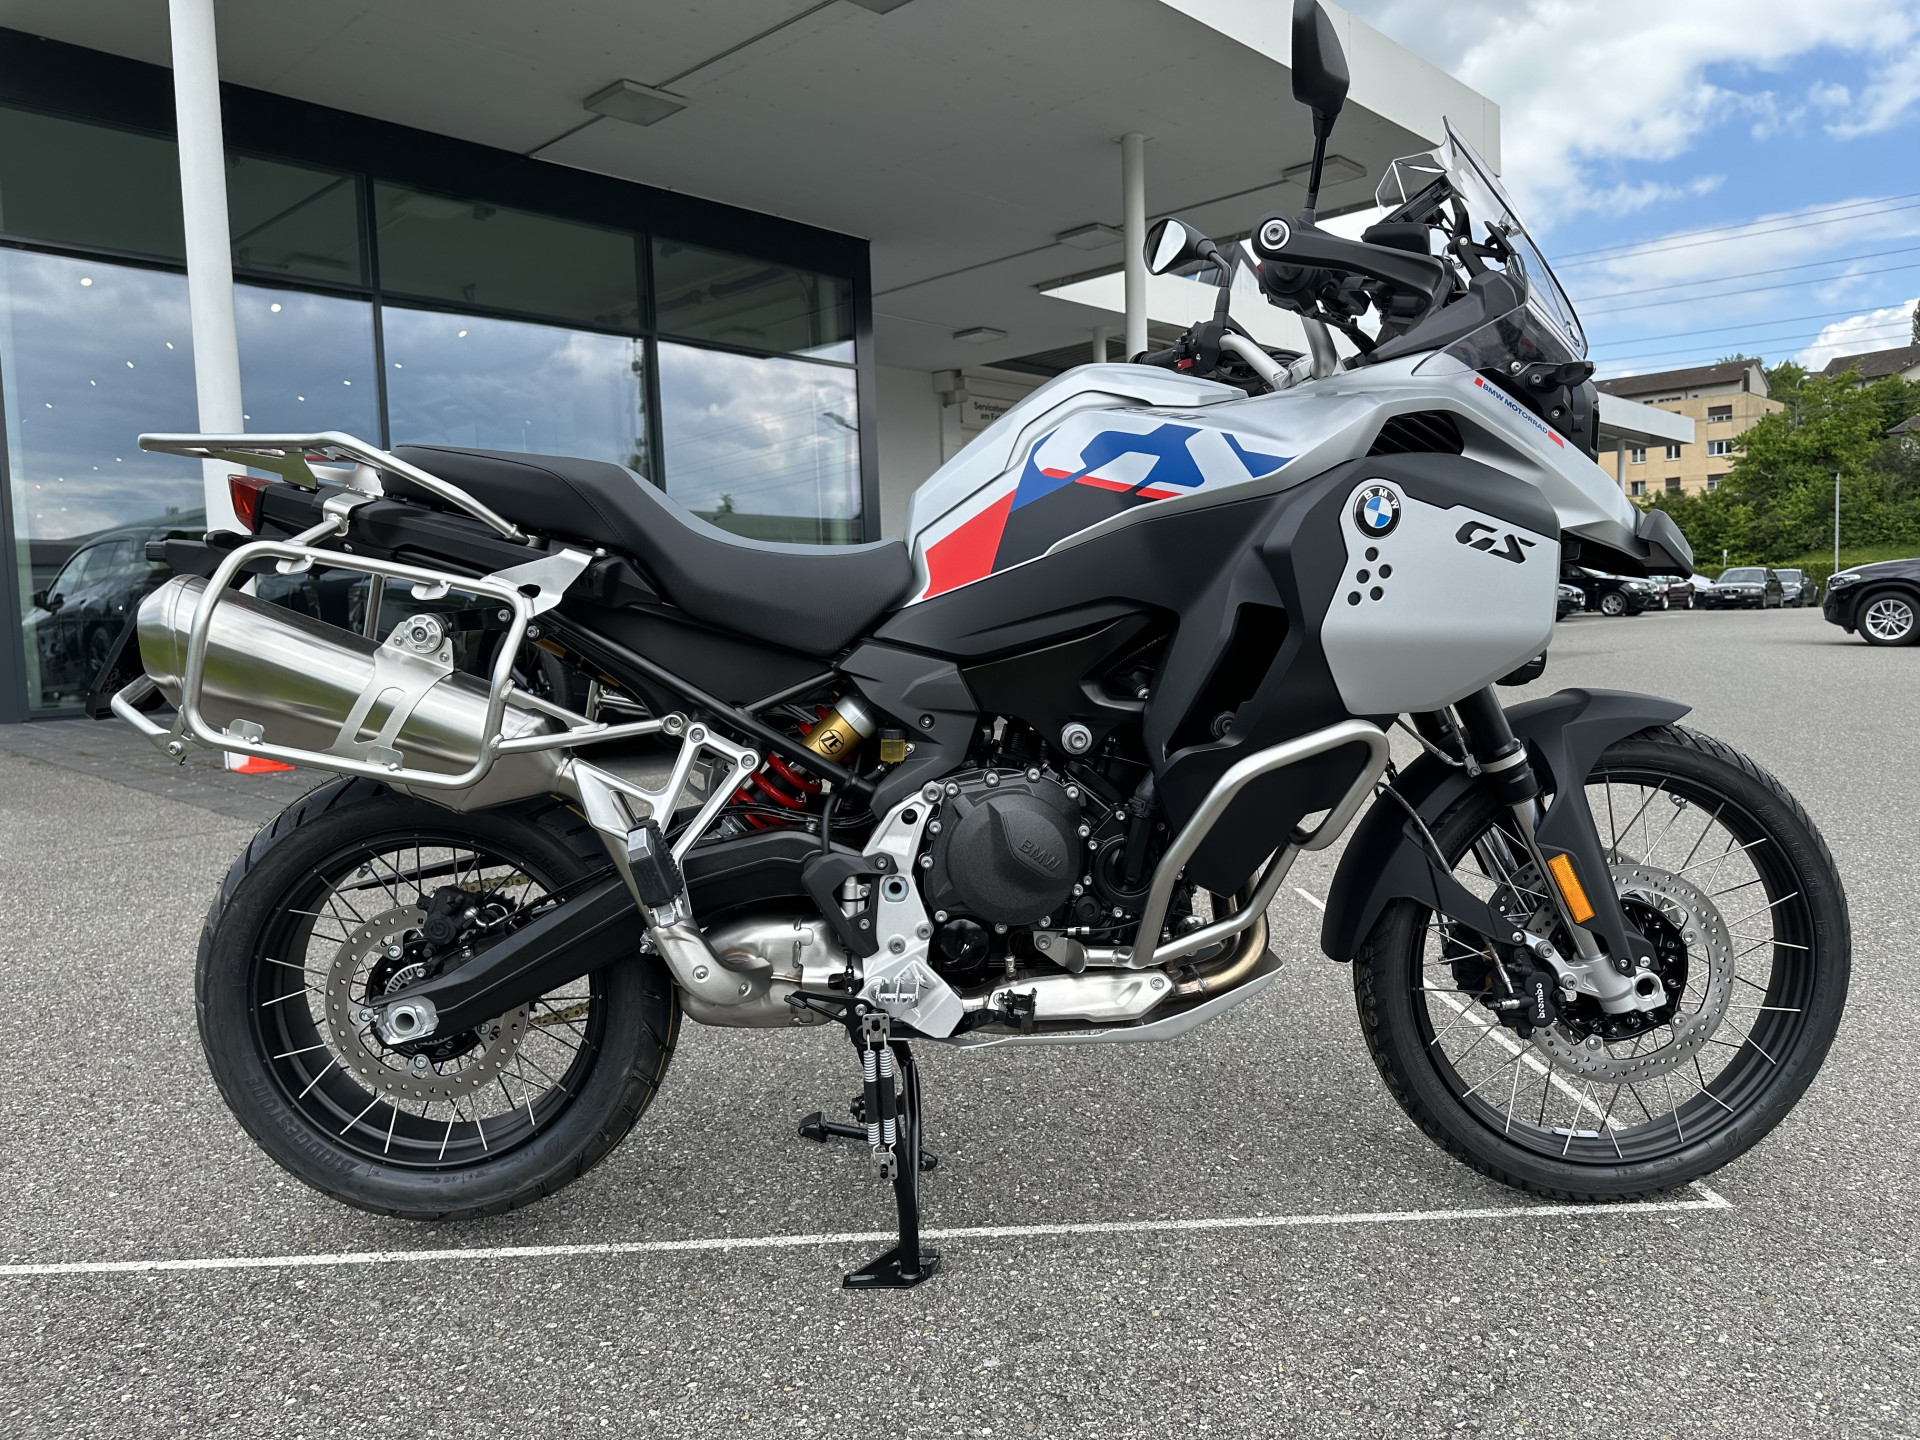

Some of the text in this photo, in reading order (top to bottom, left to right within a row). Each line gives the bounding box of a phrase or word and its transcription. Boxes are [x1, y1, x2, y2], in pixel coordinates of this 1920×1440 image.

[1482, 383, 1548, 434] BMW MOTORRAD
[1363, 488, 1400, 510] BMW
[1455, 521, 1537, 564] GS
[820, 730, 844, 754] ZF
[1018, 839, 1063, 872] BMW
[1534, 982, 1546, 1019] brembo
